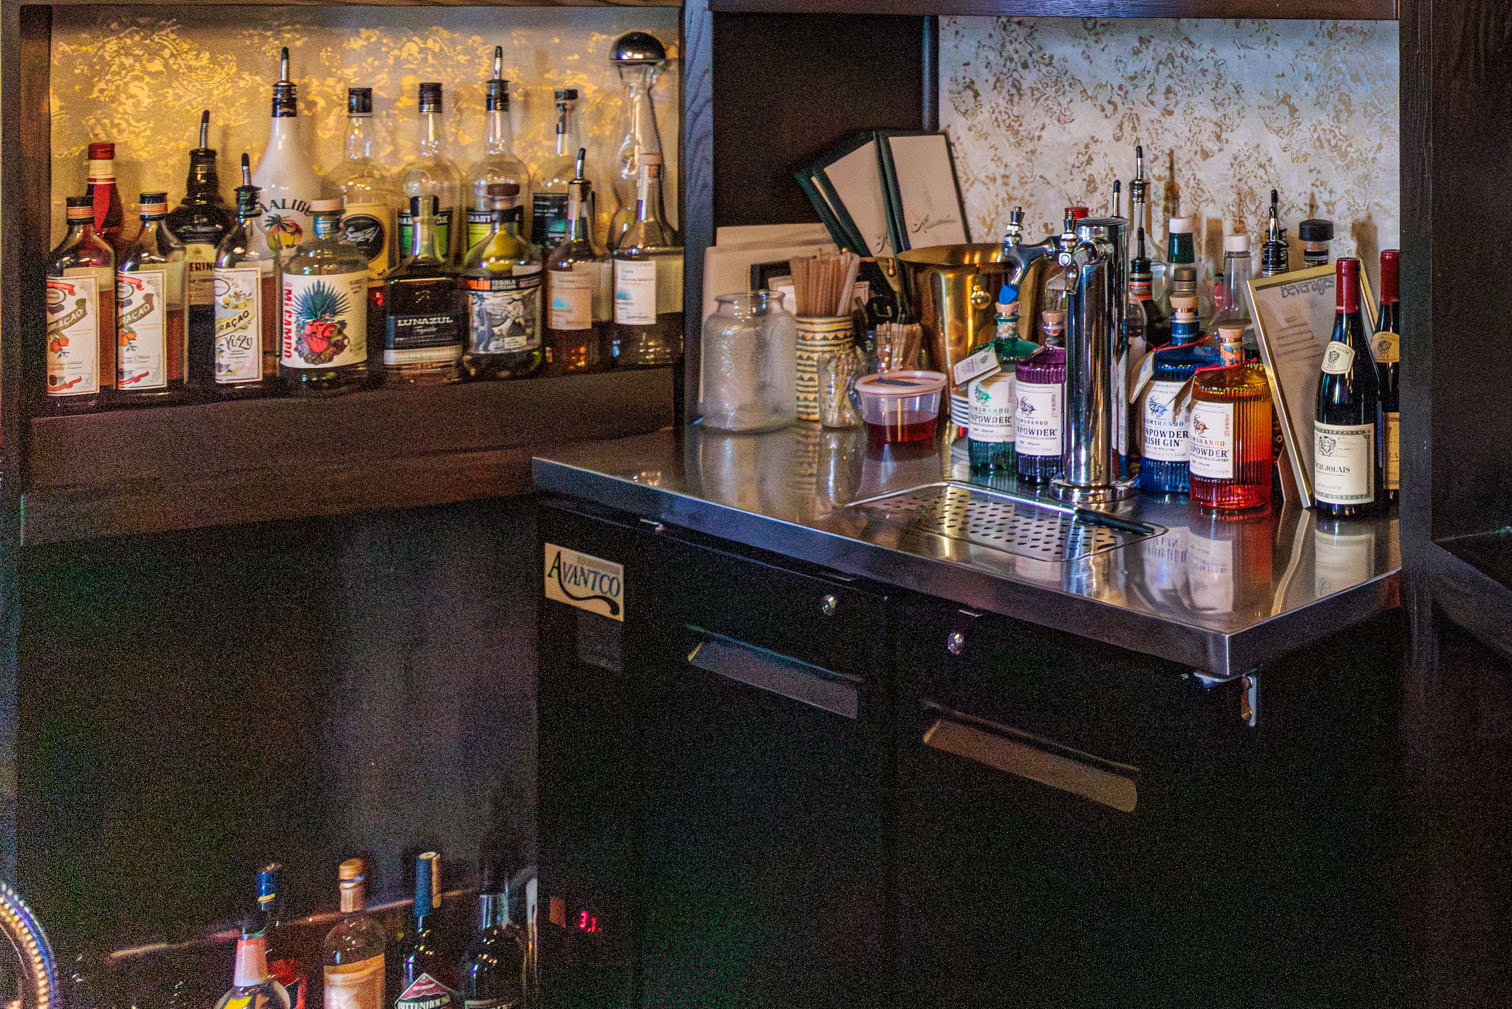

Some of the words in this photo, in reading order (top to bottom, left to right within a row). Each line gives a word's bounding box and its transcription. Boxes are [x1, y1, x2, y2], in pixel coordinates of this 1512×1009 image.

[397, 316, 453, 328] LUNAZUL
[1163, 439, 1180, 447] GIN
[547, 551, 621, 601] AVANTCO
